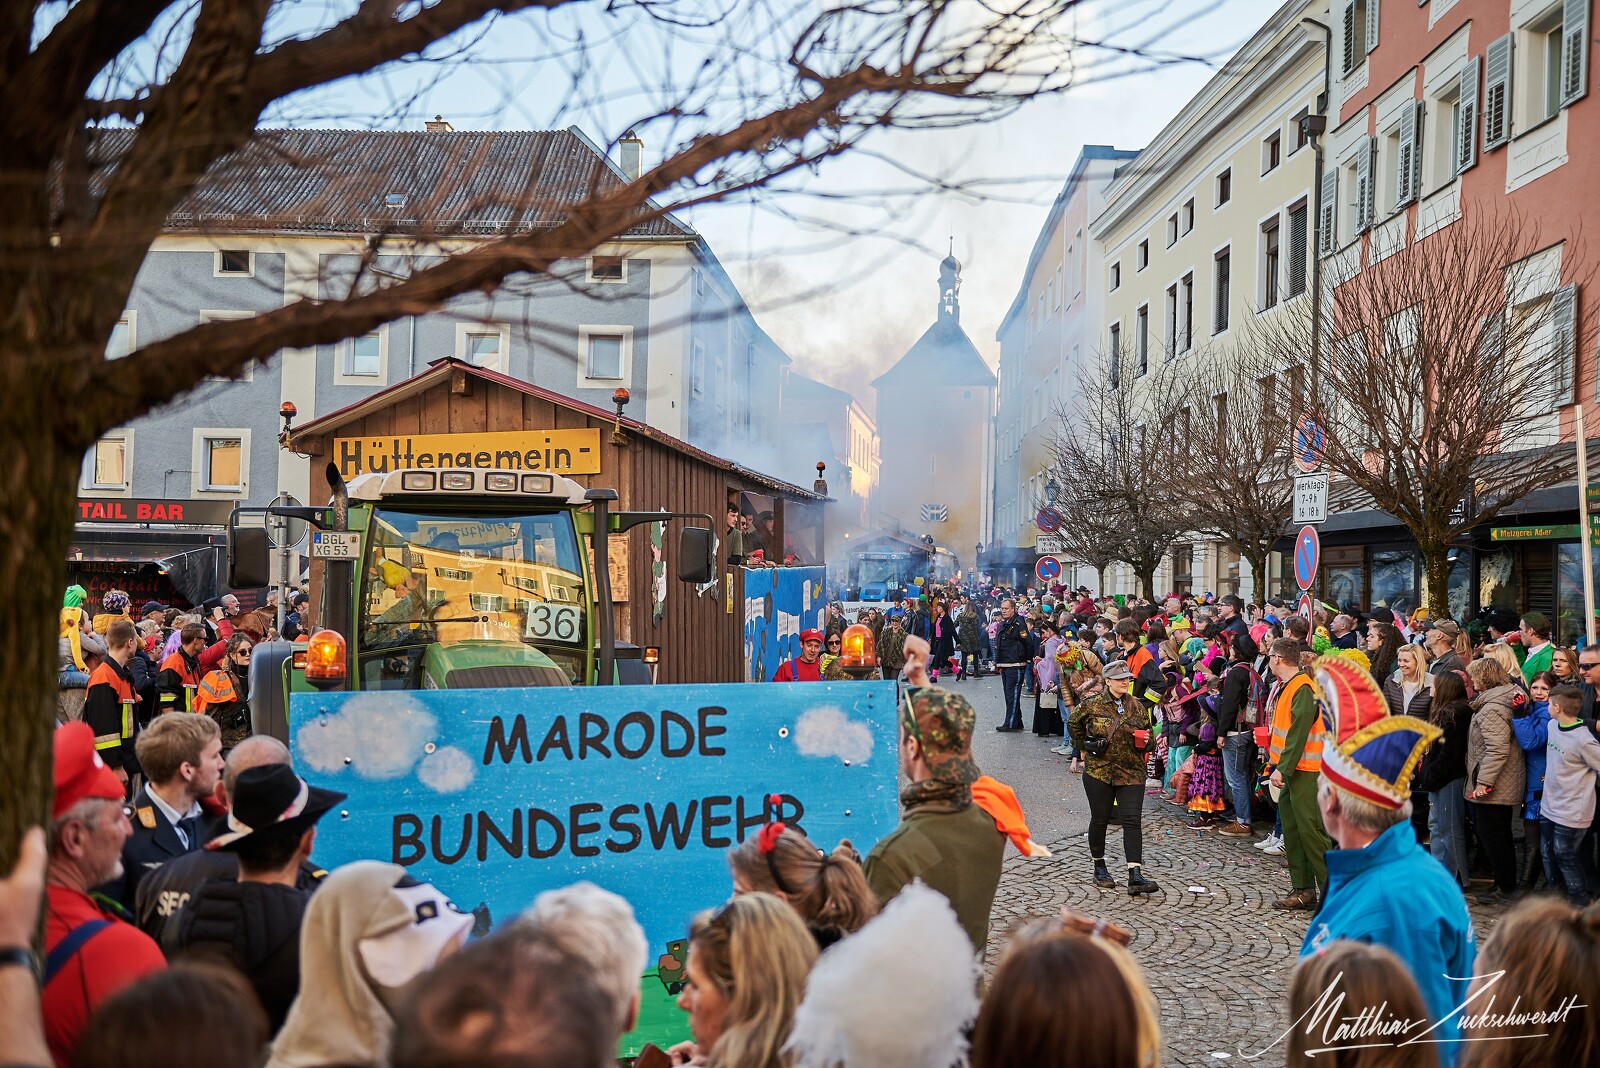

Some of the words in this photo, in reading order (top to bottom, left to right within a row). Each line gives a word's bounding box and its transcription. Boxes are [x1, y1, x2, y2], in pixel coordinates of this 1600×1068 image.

[78, 502, 127, 519] TAIL
[136, 503, 183, 520] BAR
[322, 534, 346, 545] BGL
[1500, 529, 1532, 538] Metzgerei
[315, 545, 331, 556] XG
[334, 545, 349, 556] 53
[88, 576, 160, 593] Cocktail
[530, 605, 575, 640] 36
[483, 706, 728, 765] MARODE
[392, 794, 808, 867] BUNDESWEHR
